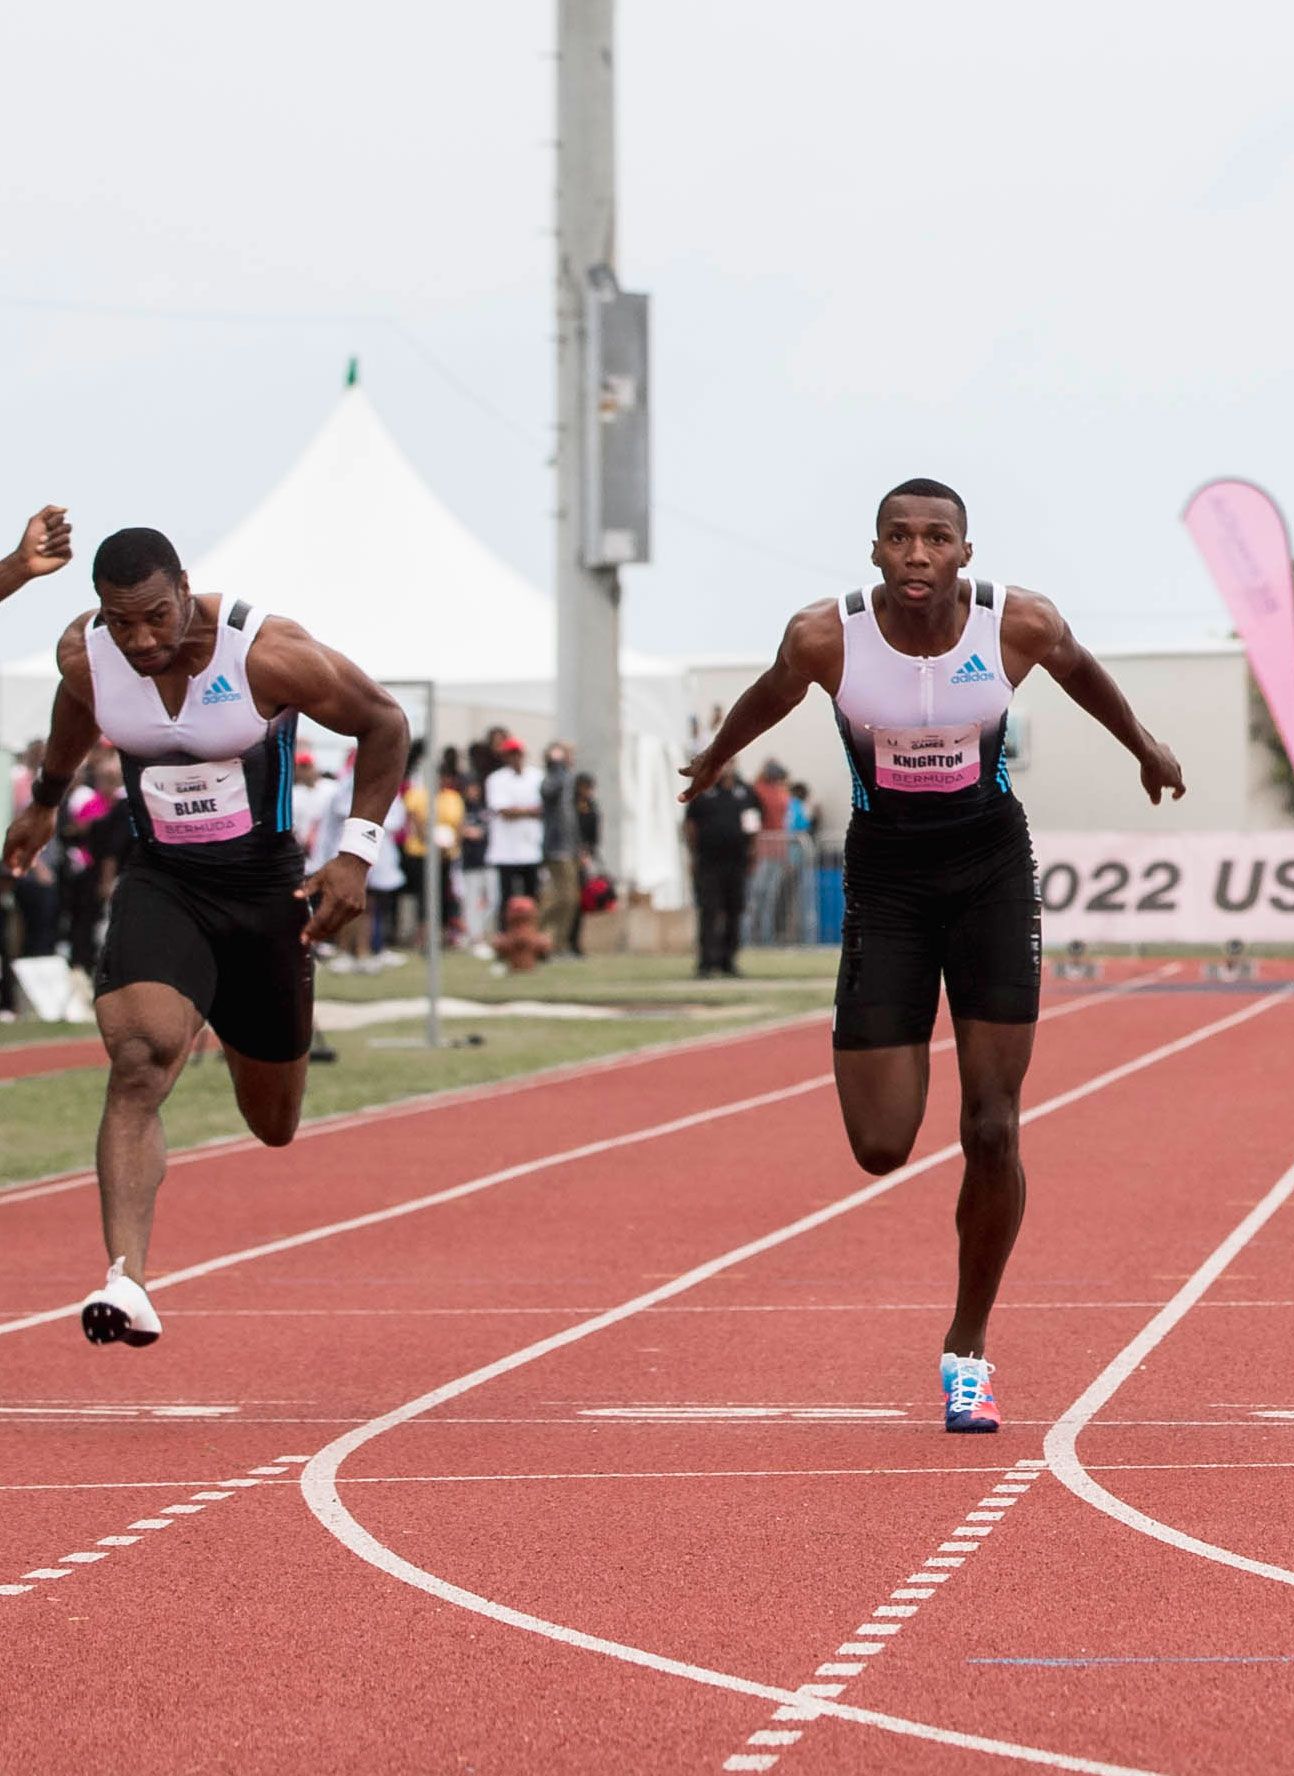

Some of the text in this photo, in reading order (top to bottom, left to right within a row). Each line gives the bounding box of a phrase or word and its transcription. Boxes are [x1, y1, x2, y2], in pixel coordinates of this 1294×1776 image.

[951, 672, 994, 684] adidas
[911, 742, 945, 750] GAMES
[893, 752, 963, 768] KNIGHTON
[892, 773, 965, 784] BERMUDA
[175, 783, 207, 793] GAMES
[174, 798, 218, 816] BLAKE
[165, 820, 236, 835] BERMUDA
[1040, 863, 1182, 913] 022
